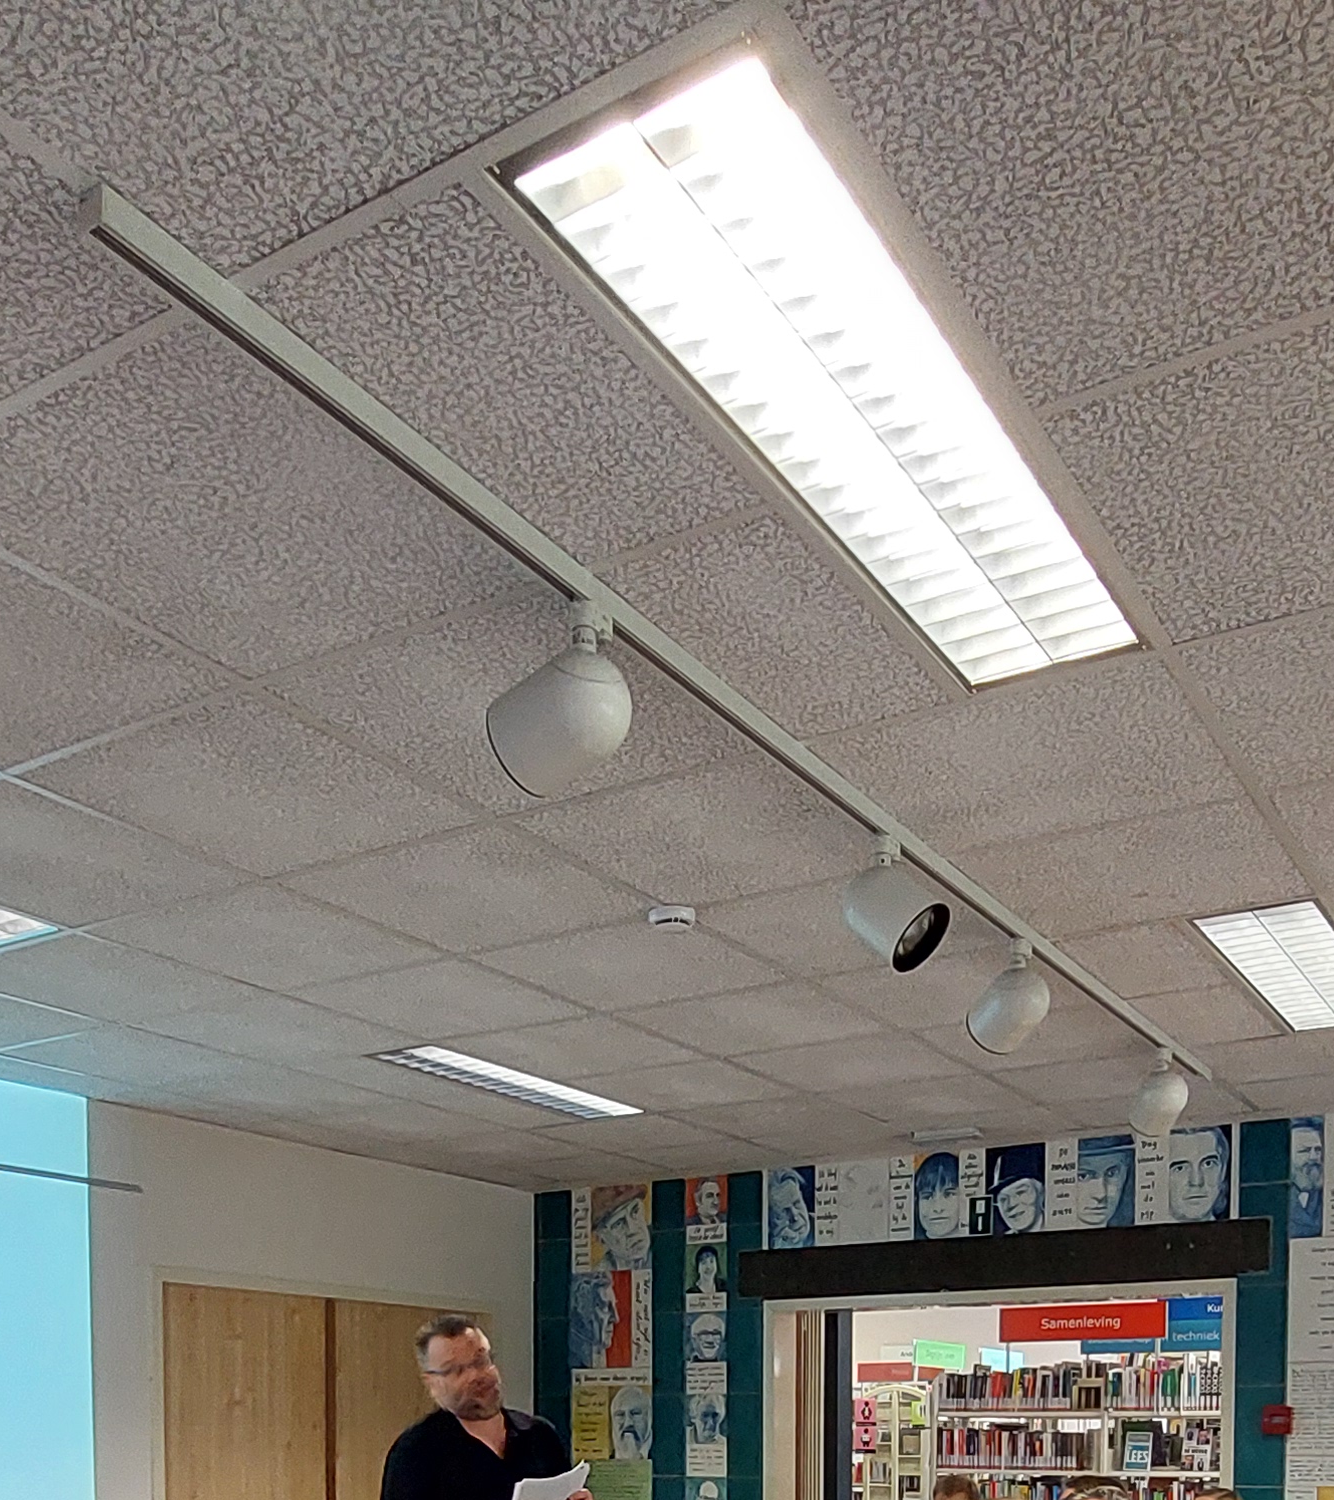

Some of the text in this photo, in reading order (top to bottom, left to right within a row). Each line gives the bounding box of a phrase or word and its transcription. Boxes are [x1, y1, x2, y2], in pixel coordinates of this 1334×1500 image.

[1040, 1315, 1121, 1330] Samenleving
[1172, 1330, 1220, 1342] techniek
[1126, 1450, 1148, 1463] LEES
